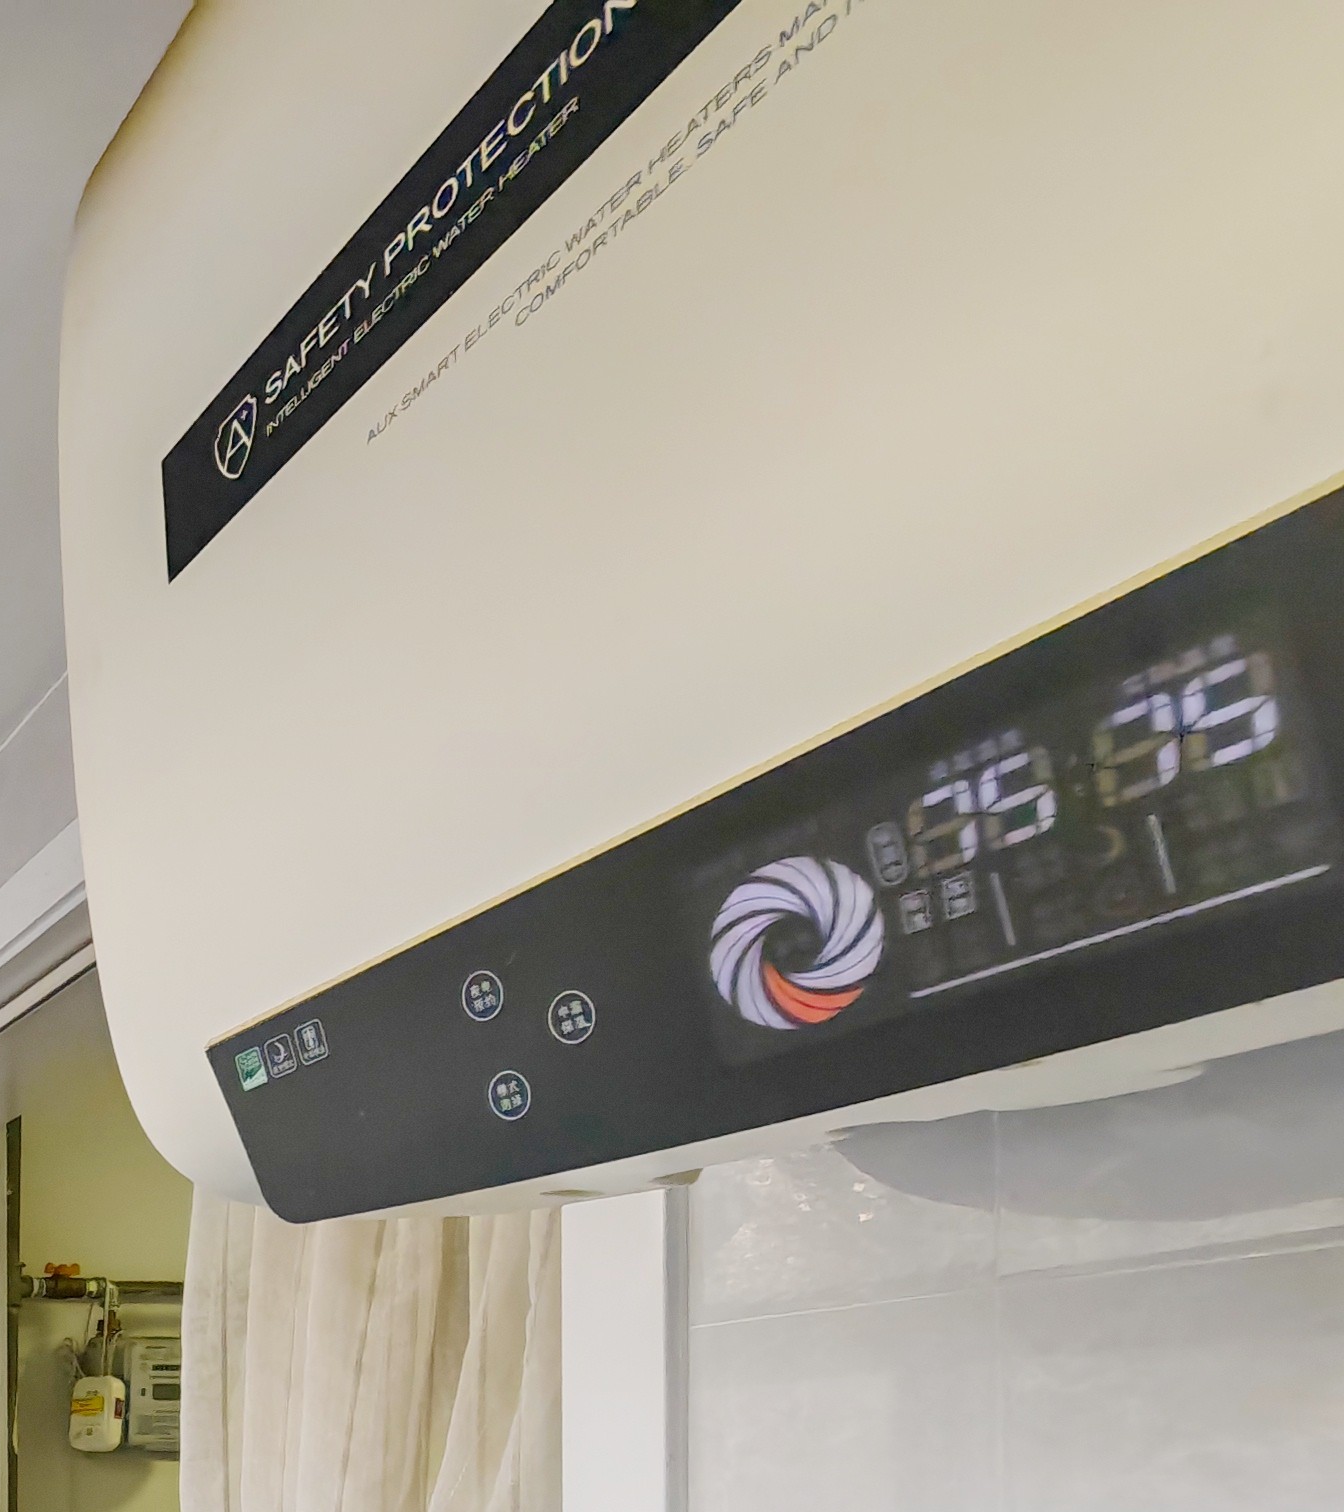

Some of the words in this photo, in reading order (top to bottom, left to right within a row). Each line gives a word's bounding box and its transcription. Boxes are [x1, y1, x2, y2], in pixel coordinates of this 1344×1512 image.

[265, 263, 377, 405] SAFETY
[383, 0, 638, 277] PROTECTION
[265, 339, 352, 438] INTELLIGENT
[353, 254, 431, 345] ELECTRIC
[432, 186, 496, 259] WATER
[498, 96, 580, 192] HEATER
[366, 404, 398, 445] AUX
[400, 344, 460, 411] SMART
[464, 250, 561, 352] ELECTRIC
[564, 170, 643, 253] WATER
[648, 44, 773, 174] HEATERS
[696, 78, 768, 158] SAFE
[774, 13, 839, 85] AND
